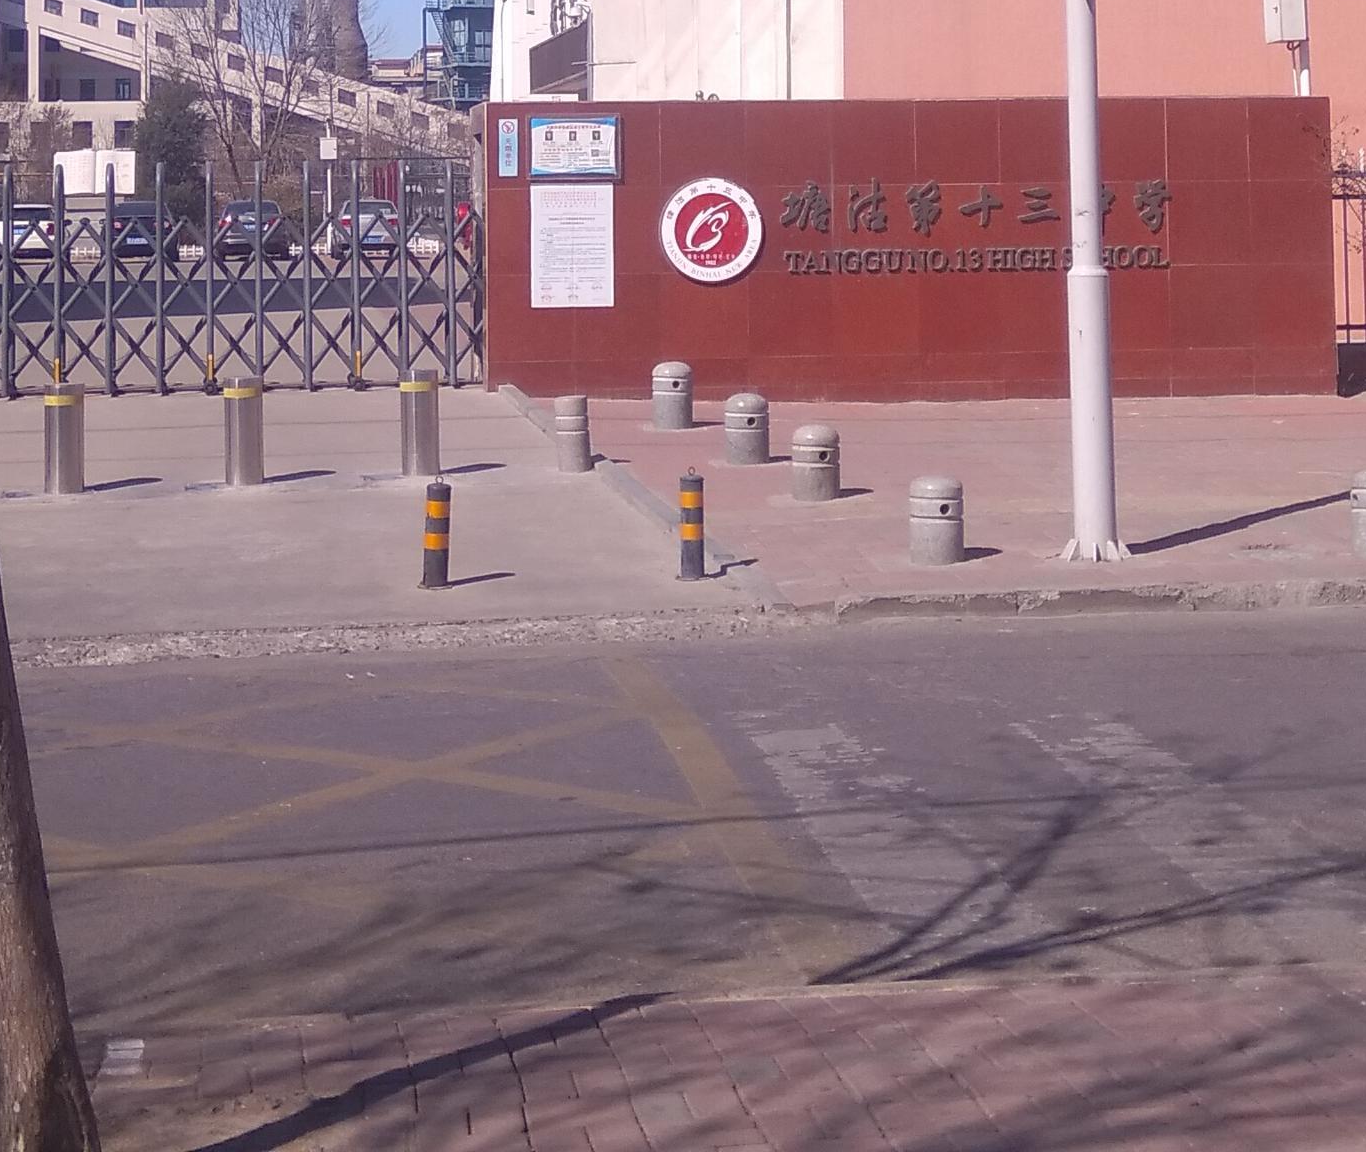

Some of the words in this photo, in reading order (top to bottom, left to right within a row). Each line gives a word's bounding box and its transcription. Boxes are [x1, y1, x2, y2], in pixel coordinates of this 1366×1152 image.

[783, 248, 905, 275] TANGGU
[986, 247, 1057, 273] HIGH
[1062, 245, 1172, 271] SHOOL
